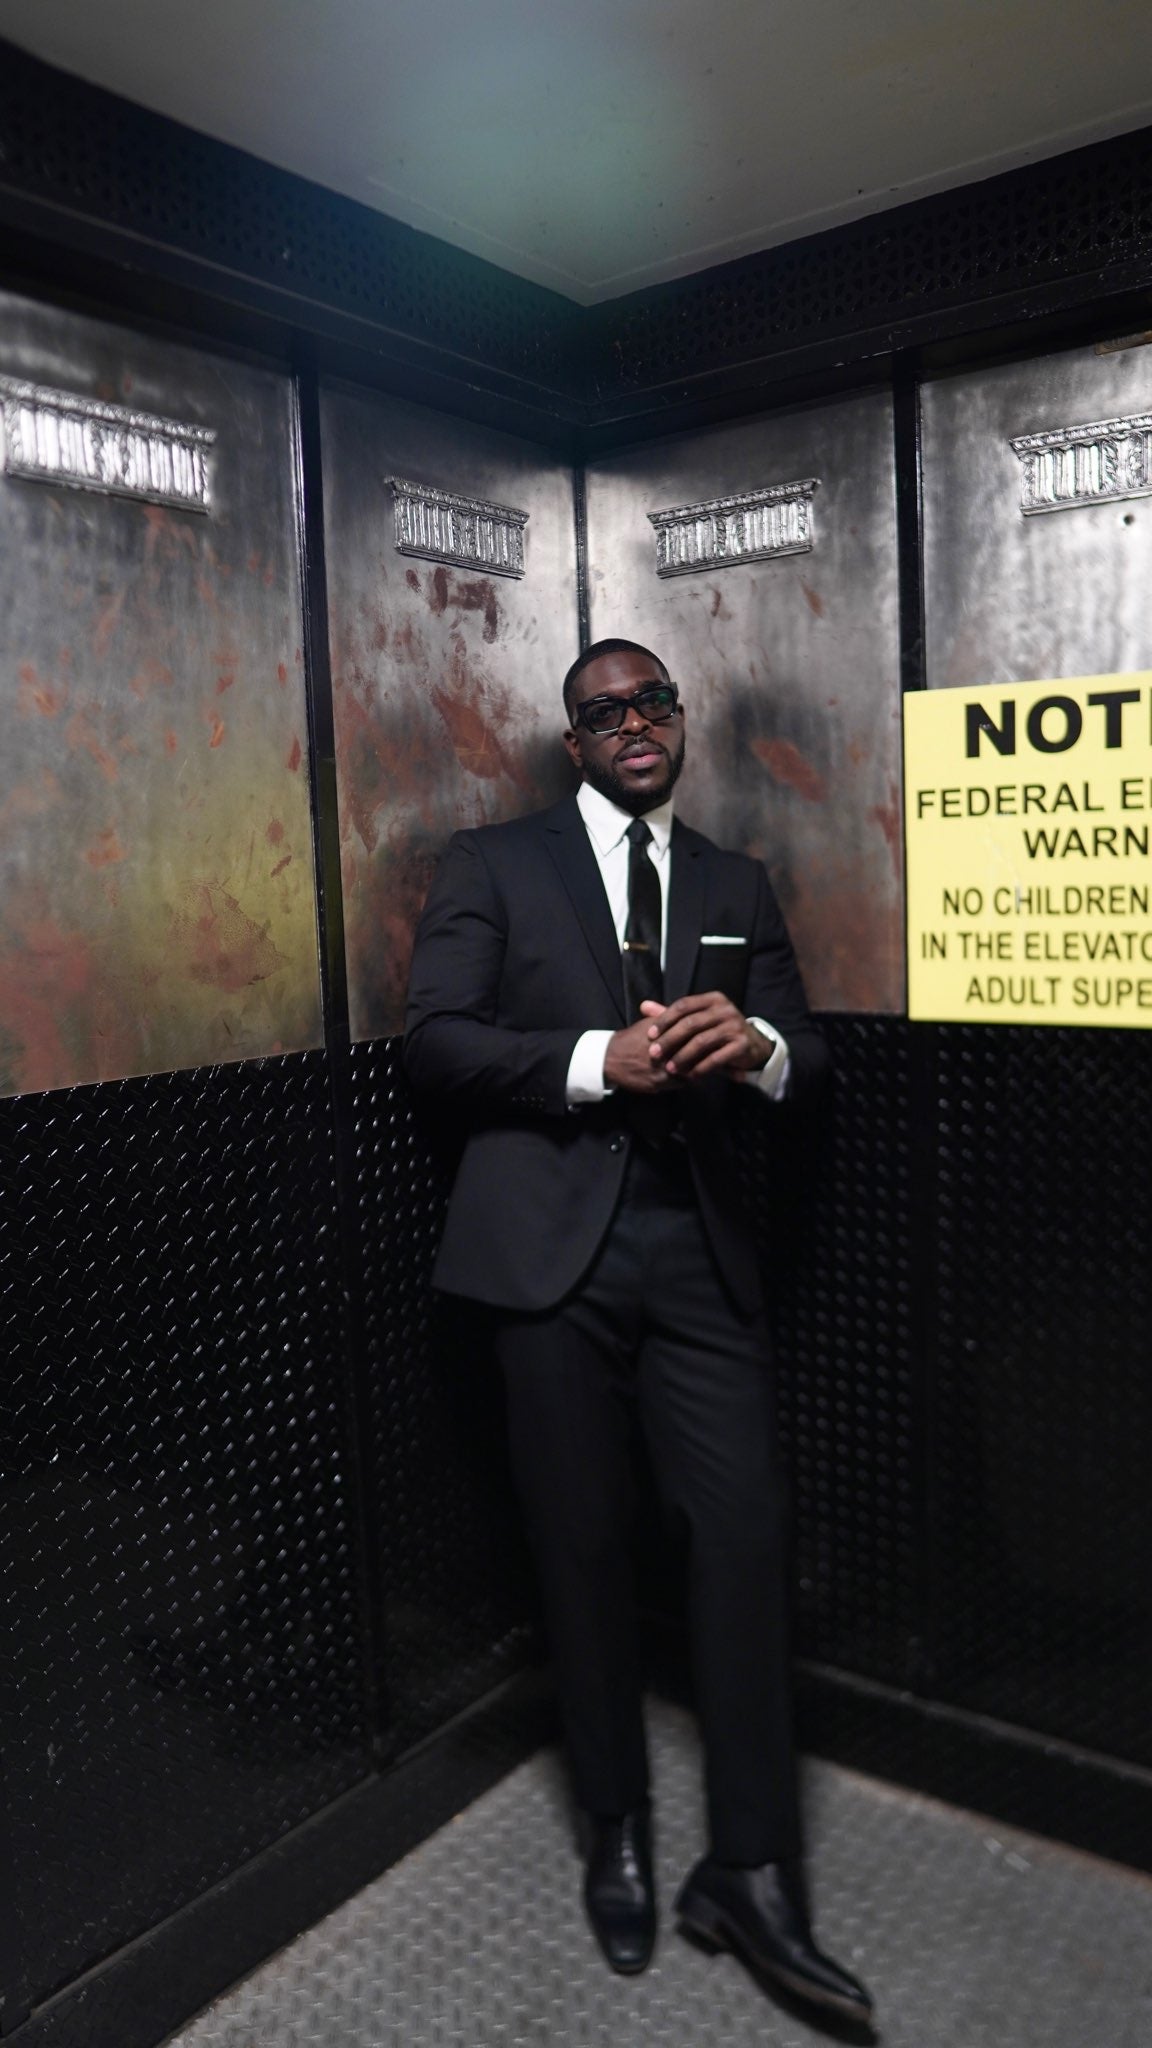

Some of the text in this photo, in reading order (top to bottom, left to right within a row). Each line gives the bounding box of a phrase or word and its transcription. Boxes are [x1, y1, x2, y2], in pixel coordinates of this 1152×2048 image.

[964, 687, 1152, 759] NOT
[917, 778, 1152, 819] FEDERAL E
[943, 885, 1148, 916] NO CHILDREN
[922, 933, 946, 959] IN
[958, 932, 1012, 960] THE
[966, 976, 1061, 1005] ADULT
